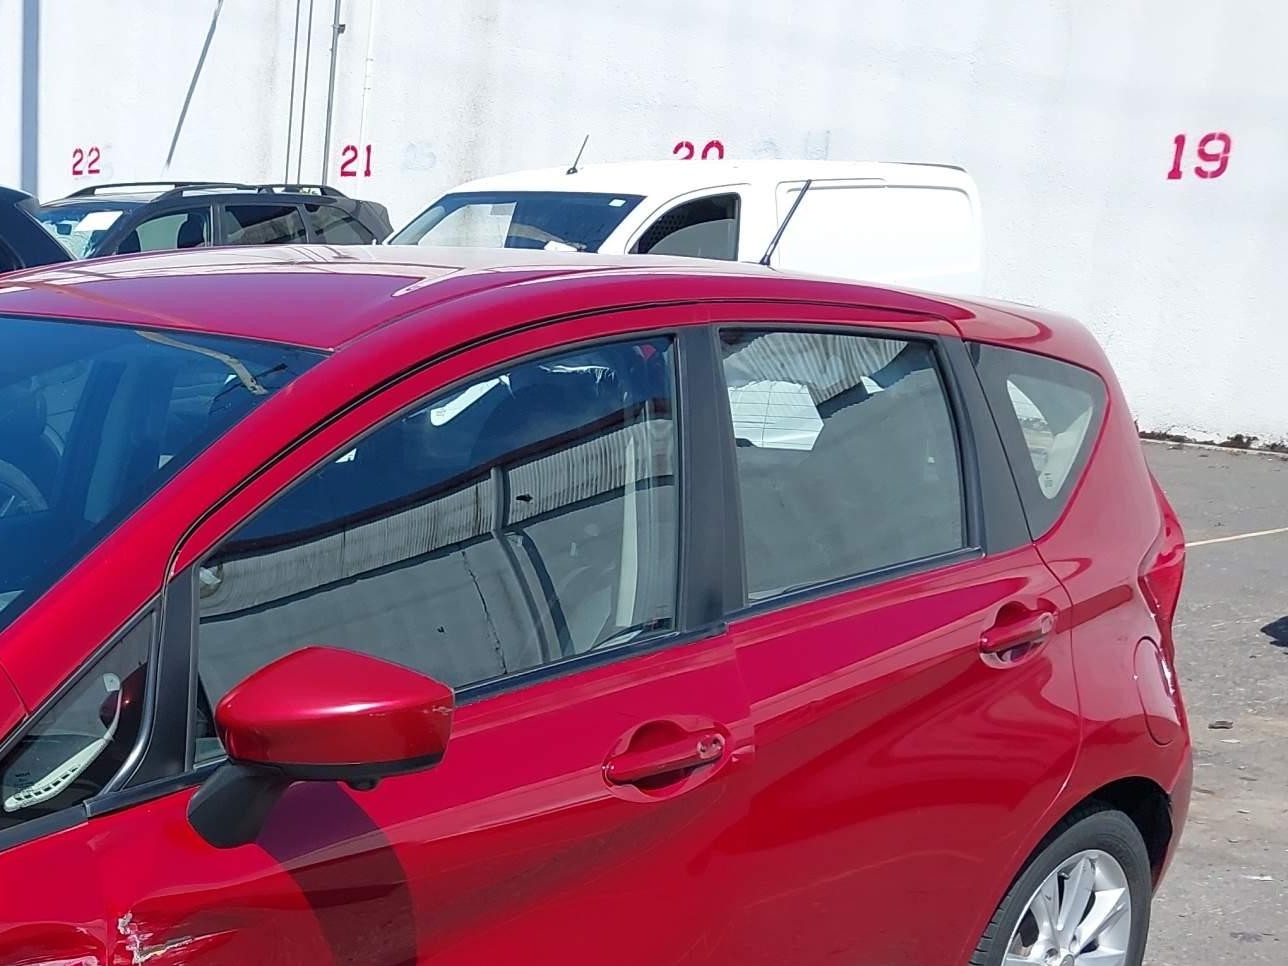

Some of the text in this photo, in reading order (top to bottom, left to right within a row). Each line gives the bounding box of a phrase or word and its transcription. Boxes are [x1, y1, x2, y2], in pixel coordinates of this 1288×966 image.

[71, 146, 101, 176] 22
[340, 144, 373, 177] 21
[1166, 132, 1232, 180] 19
